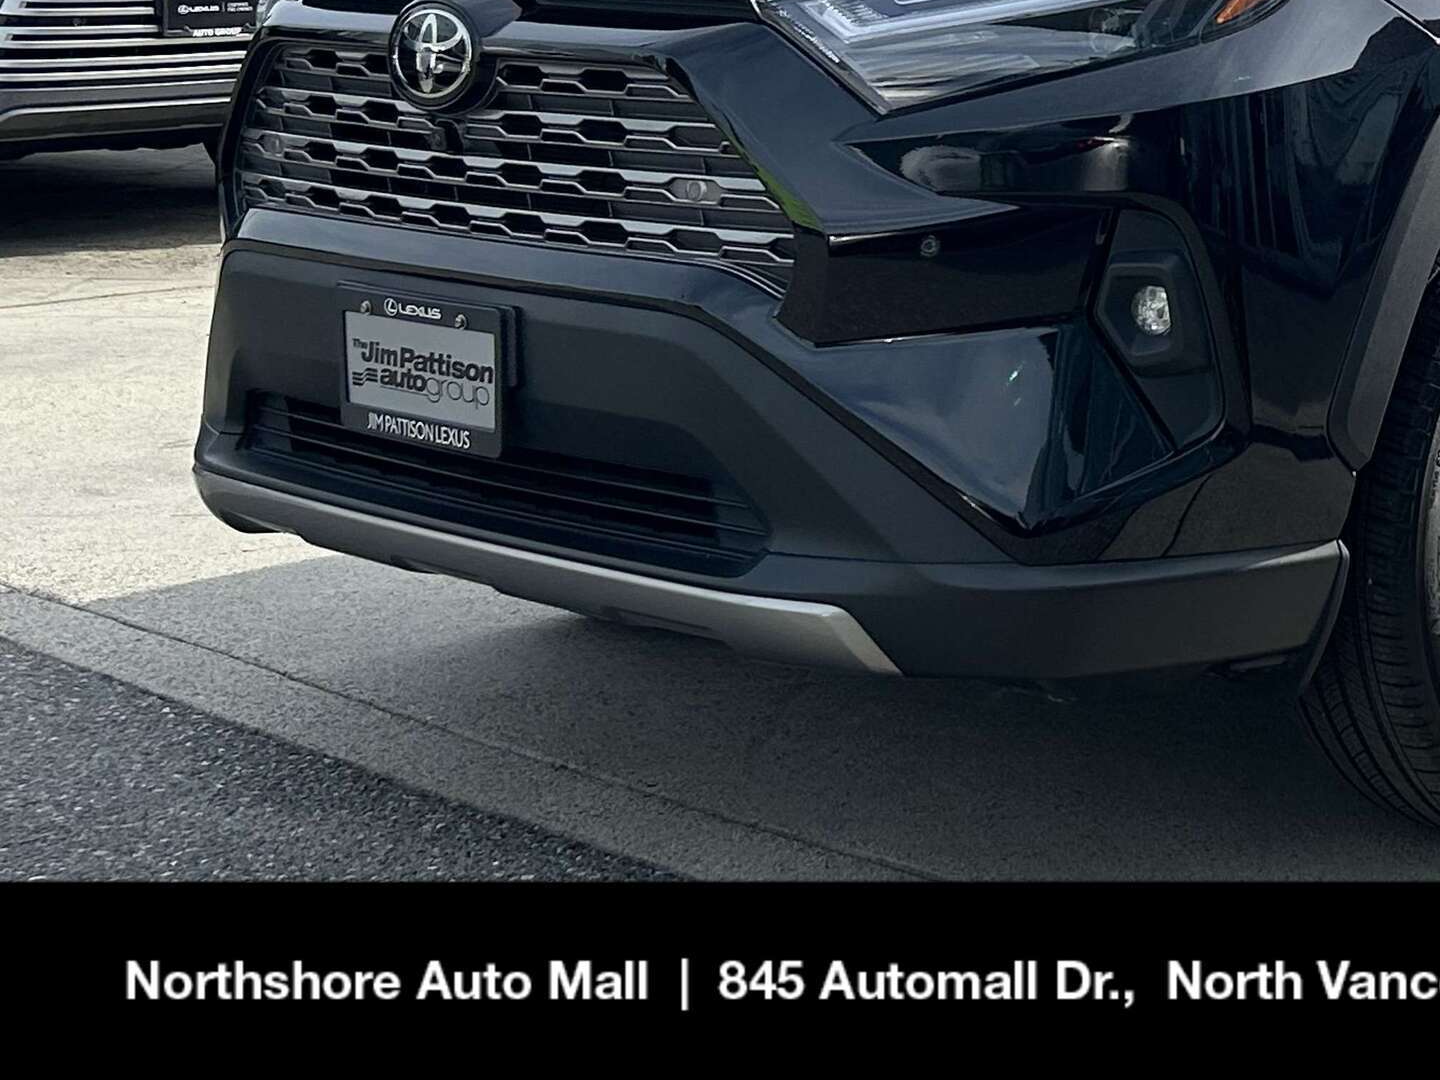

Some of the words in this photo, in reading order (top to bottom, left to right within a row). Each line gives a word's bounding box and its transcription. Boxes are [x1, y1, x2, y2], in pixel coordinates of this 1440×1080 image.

[398, 303, 442, 320] LEXUS
[352, 337, 368, 350] The
[368, 412, 384, 432] JIM
[385, 415, 434, 443] PATTISON
[435, 427, 471, 450] LEXUS
